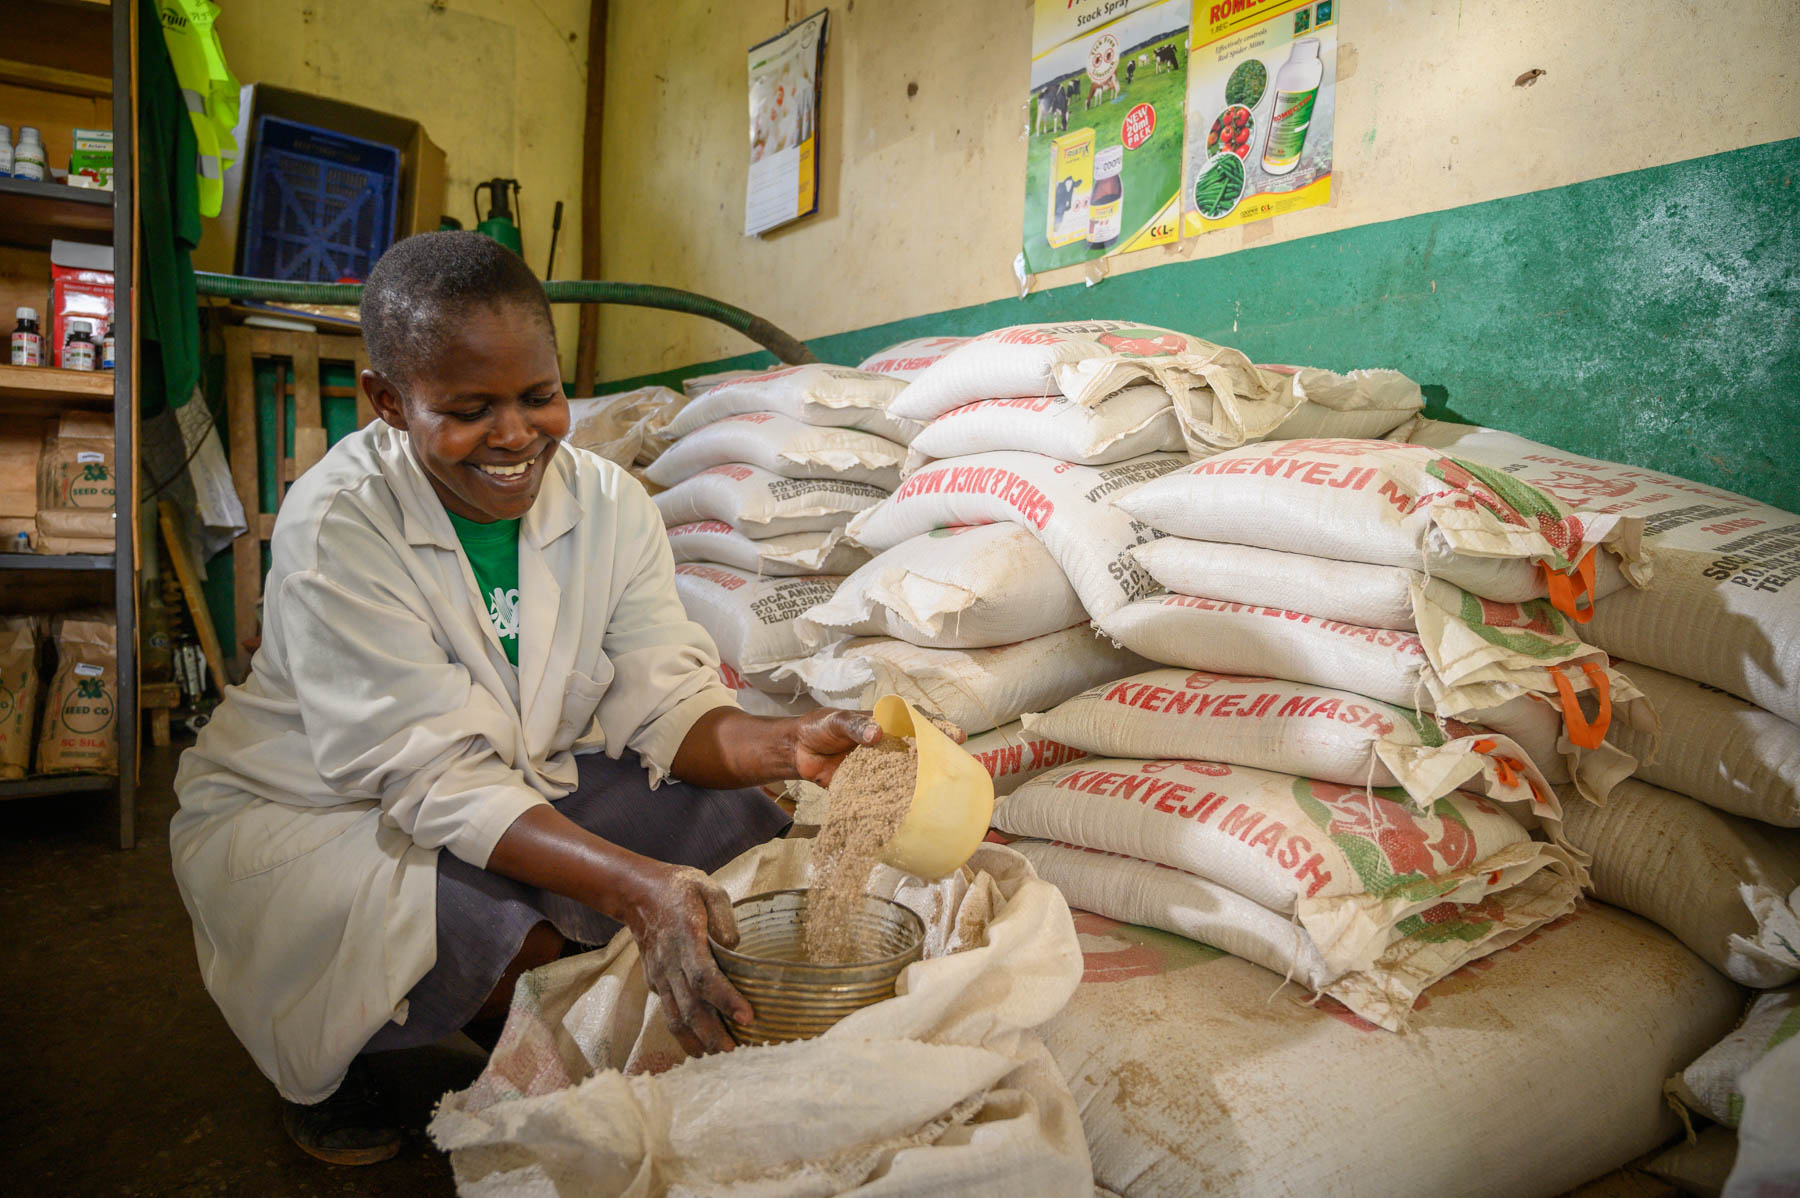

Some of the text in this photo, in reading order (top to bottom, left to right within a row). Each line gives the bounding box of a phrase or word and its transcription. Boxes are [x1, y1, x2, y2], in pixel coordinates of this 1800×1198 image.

[1077, 7, 1102, 27] Stock
[1104, 0, 1130, 16] Spray
[1210, 0, 1266, 25] ROM
[1215, 27, 1268, 54] Effectively controls
[1217, 52, 1229, 62] Red
[1229, 46, 1247, 58] Spider
[1126, 104, 1148, 128] NEW
[1127, 117, 1150, 139] 20ml
[1127, 126, 1151, 147] PACK
[1151, 224, 1169, 238] CCL
[1098, 460, 1157, 481] ENRICHED
[1193, 457, 1377, 490] KIENYEJI
[73, 487, 97, 496] SEED
[896, 468, 949, 504] MASH
[1085, 472, 1146, 504] VITAMINS
[1144, 470, 1158, 479] &
[1731, 567, 1770, 588] P.O.
[750, 585, 836, 611] SOCA ANIMAL
[755, 606, 778, 617] P.O.
[777, 601, 800, 612] BOX
[65, 706, 109, 715] SEED CO
[1104, 682, 1395, 737] KIENYEJI MASH
[79, 738, 106, 748] SILA
[972, 744, 1022, 778] MA
[1055, 769, 1228, 824] KIENYEJI
[1217, 803, 1333, 899] MASH
